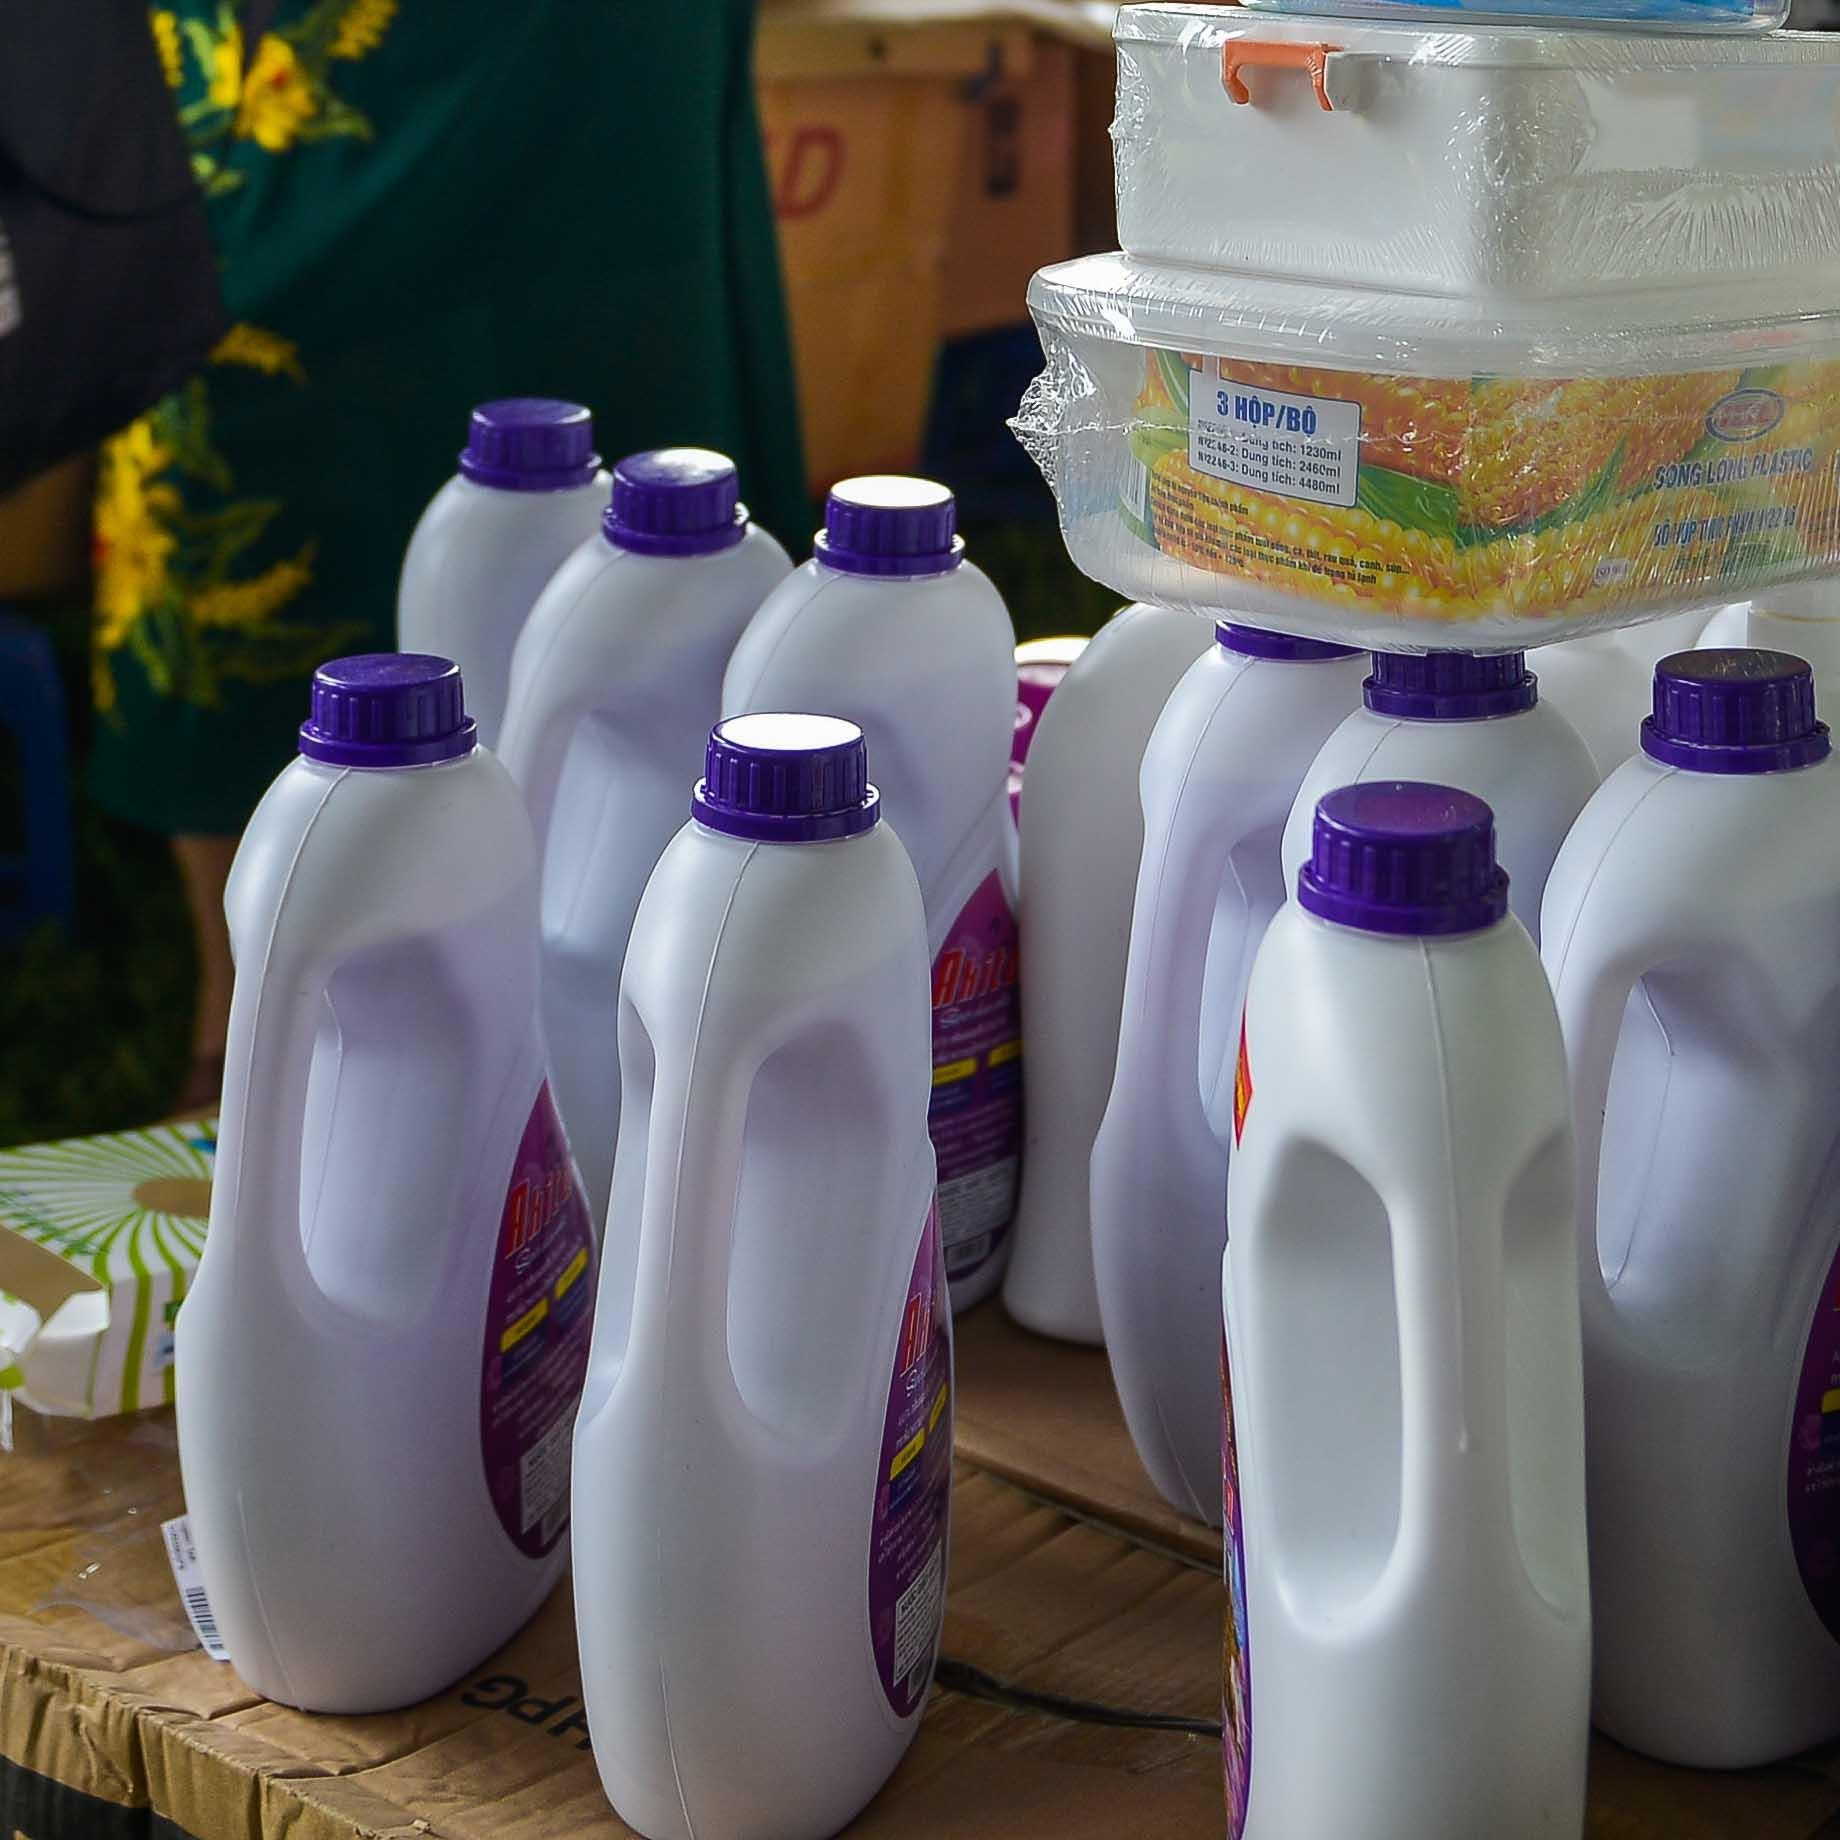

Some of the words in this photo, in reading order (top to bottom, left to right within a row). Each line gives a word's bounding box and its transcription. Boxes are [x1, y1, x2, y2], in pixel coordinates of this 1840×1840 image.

[1216, 391, 1229, 416] 3
[1234, 395, 1318, 438] HỘP/BỘ
[1241, 448, 1269, 466] Dung
[1299, 461, 1341, 478] 2460ml
[1300, 445, 1342, 461] 1230ml
[1241, 463, 1269, 482] Dung
[1272, 469, 1296, 486] tích:
[1299, 476, 1340, 495] 4480ml
